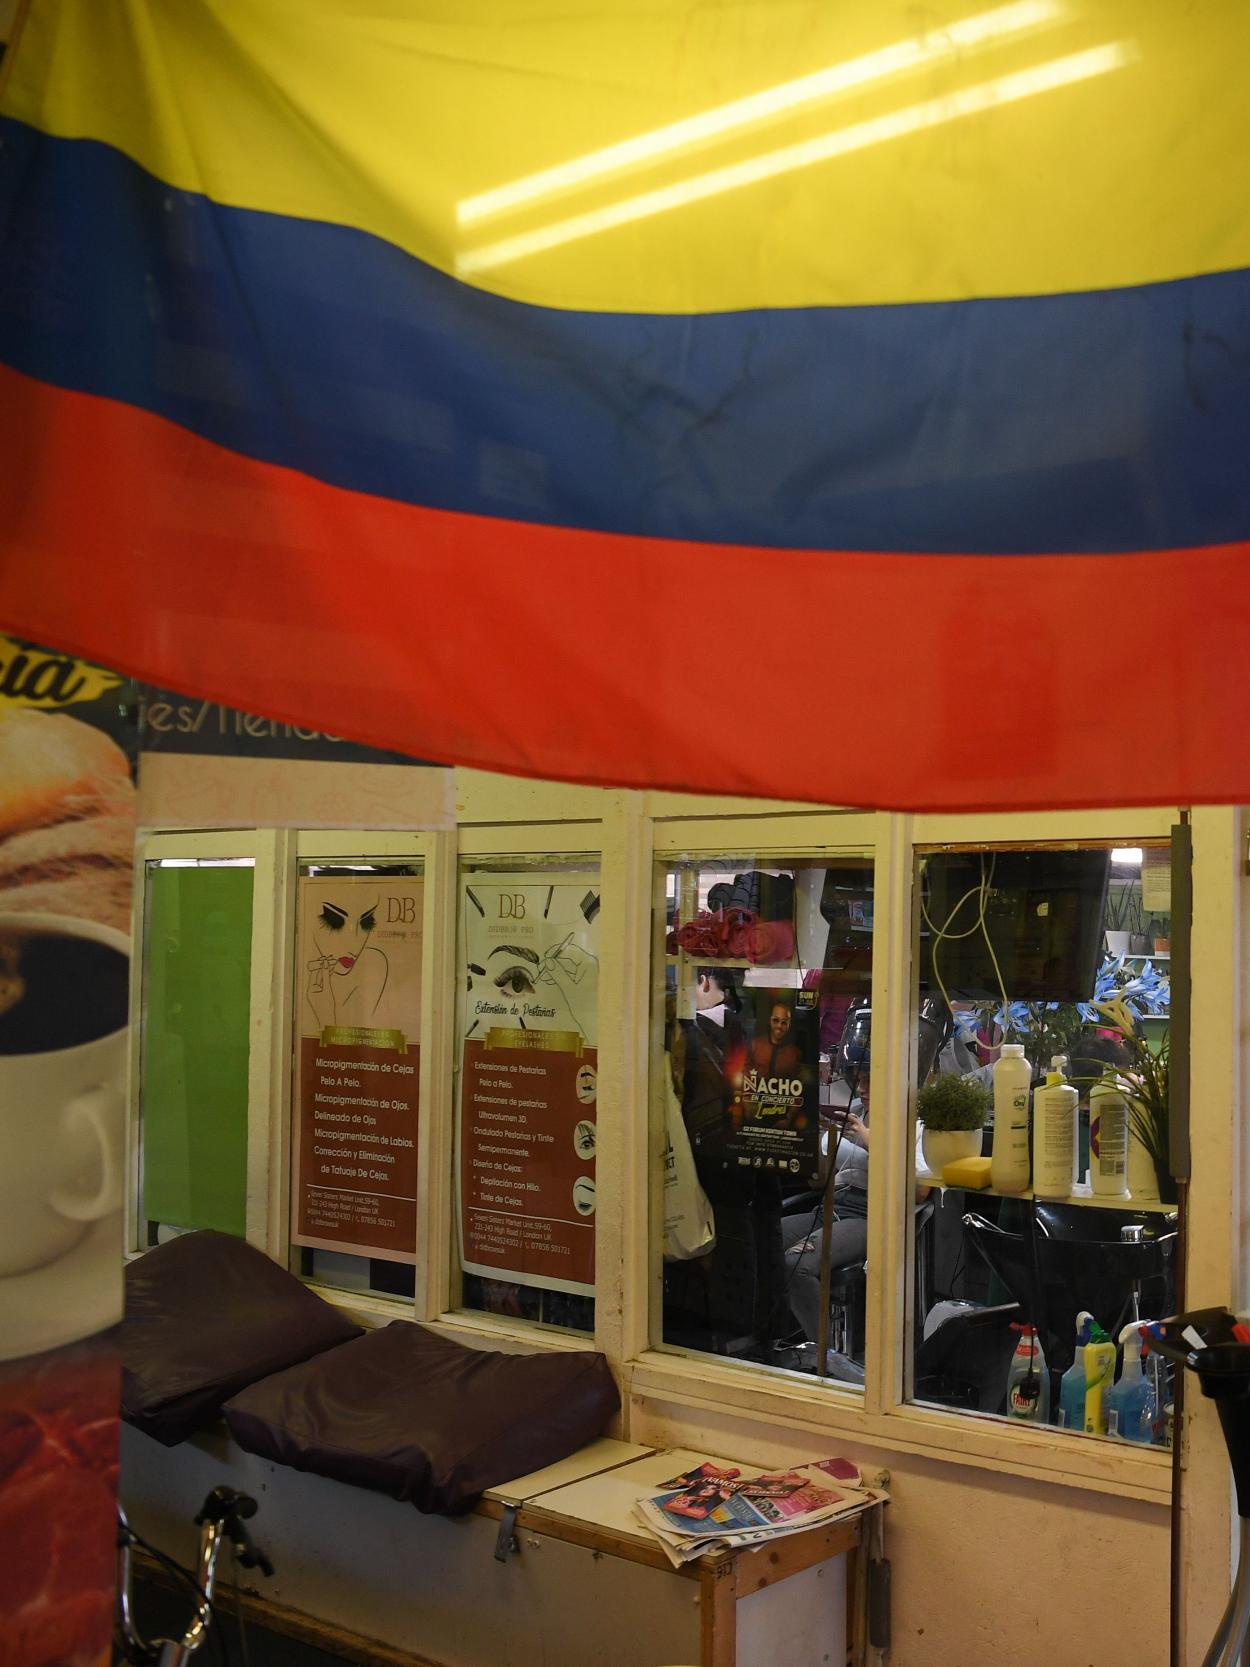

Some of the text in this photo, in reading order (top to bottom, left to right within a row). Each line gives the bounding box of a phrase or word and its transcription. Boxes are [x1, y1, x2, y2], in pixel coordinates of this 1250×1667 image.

[497, 894, 526, 919] DB
[381, 1063, 391, 1072] de
[393, 1064, 414, 1075] Cejas
[474, 1061, 508, 1072] Extensiones
[510, 1064, 518, 1072] de
[320, 1076, 335, 1086] Pelo
[336, 1078, 342, 1086] A
[480, 1079, 492, 1087] Pelo
[743, 1075, 803, 1097] NACHO
[380, 1099, 390, 1109] de
[474, 1094, 508, 1104] Extensiones
[509, 1097, 517, 1105] de
[315, 1111, 350, 1122] Delineado
[352, 1113, 361, 1123] de
[315, 1128, 379, 1143] Micropigmentación
[381, 1135, 389, 1145] de
[473, 1126, 503, 1137] Ondulado
[538, 1134, 554, 1143] Tinte
[314, 1146, 352, 1158] Corrección
[353, 1151, 358, 1160] y
[494, 1161, 502, 1169] de
[321, 1164, 330, 1173] de
[332, 1165, 357, 1177] Tatuaje
[358, 1168, 368, 1178] De
[514, 1182, 526, 1190] con
[480, 1192, 493, 1202] Tinte
[495, 1194, 503, 1203] de
